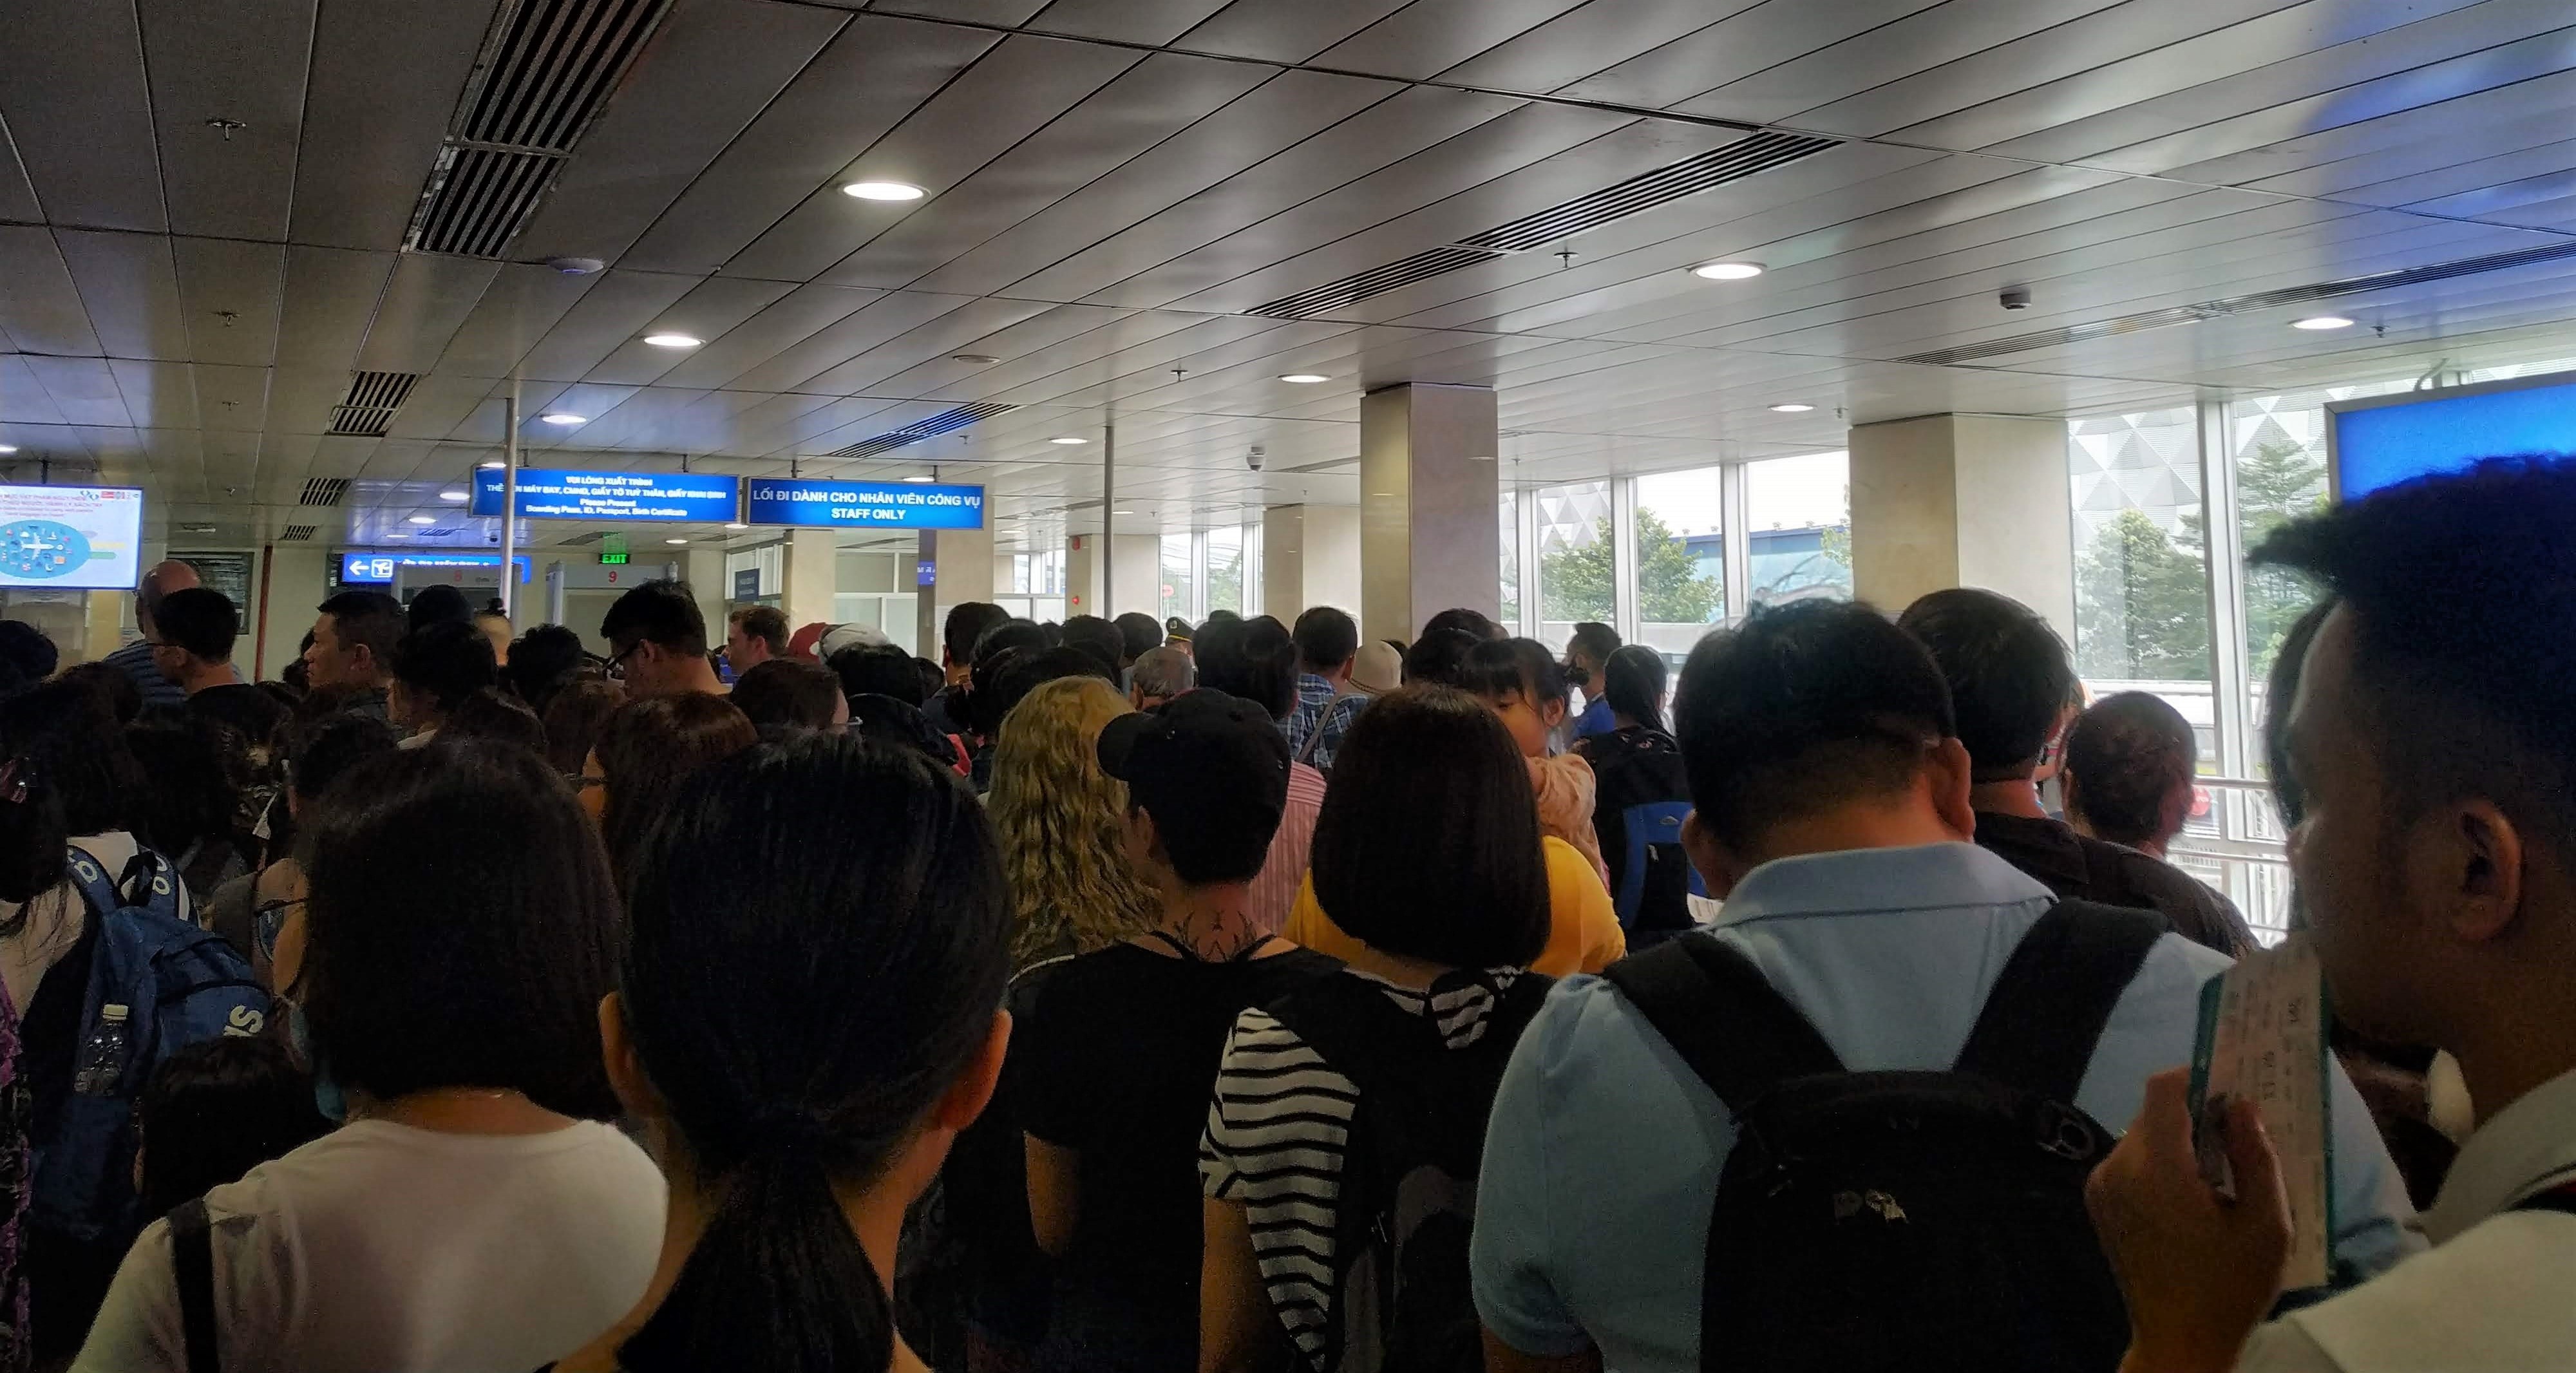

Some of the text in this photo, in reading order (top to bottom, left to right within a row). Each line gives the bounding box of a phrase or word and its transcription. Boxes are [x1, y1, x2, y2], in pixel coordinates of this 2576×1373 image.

[486, 483, 504, 492] THẺ
[524, 484, 542, 493] MÁY
[753, 487, 980, 509] LỐI ĐI DÀNH CHO NHÂN VIÊN CÔNG VỤ
[526, 505, 560, 514] Boarding
[831, 508, 906, 520] STAFF ONLY
[602, 554, 628, 563] EXIT
[608, 570, 618, 583] 9
